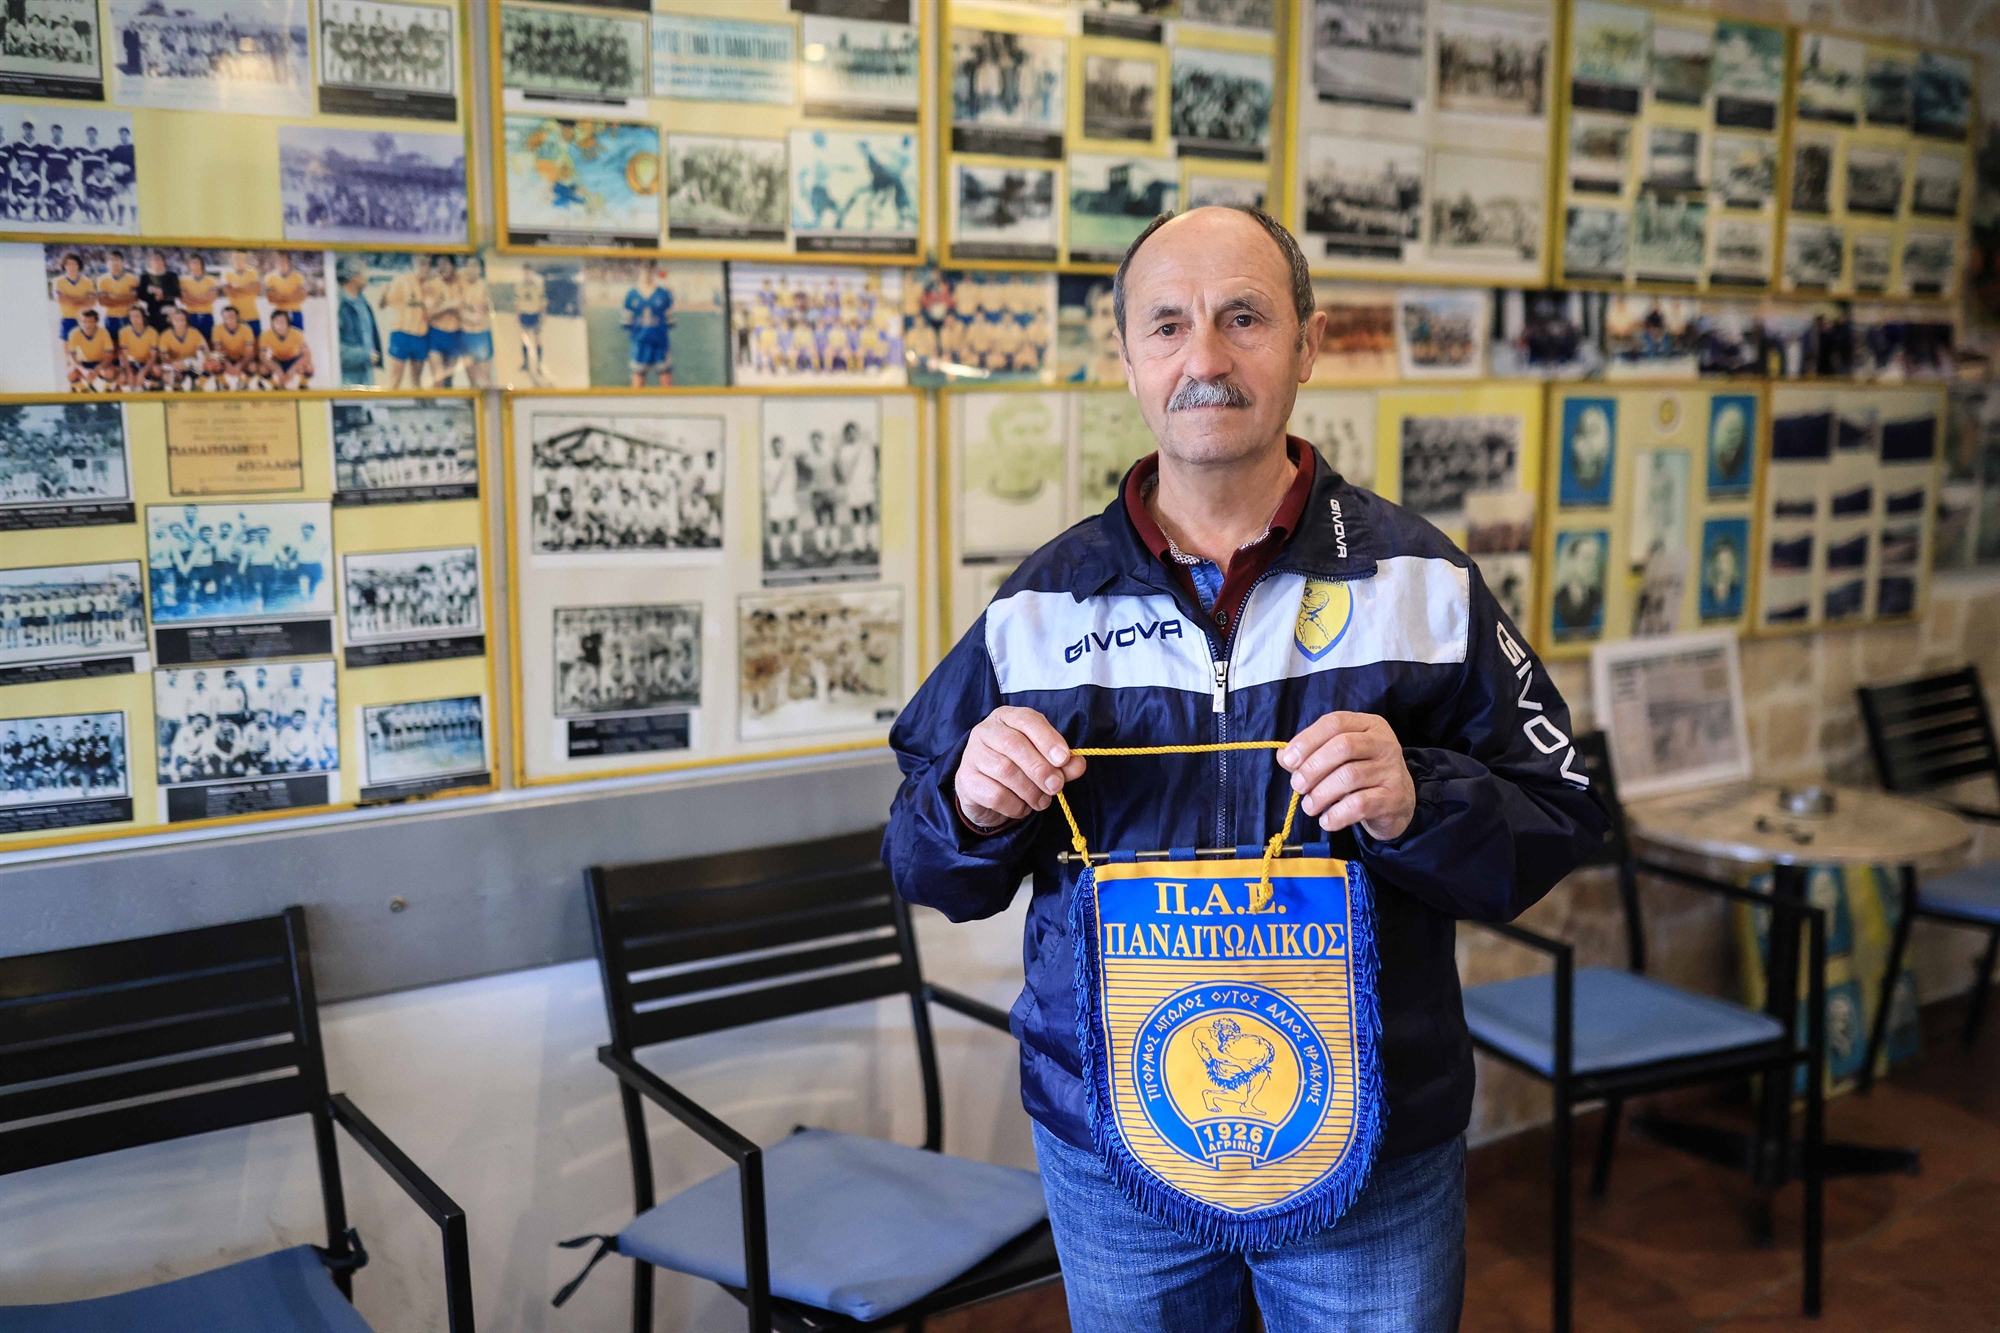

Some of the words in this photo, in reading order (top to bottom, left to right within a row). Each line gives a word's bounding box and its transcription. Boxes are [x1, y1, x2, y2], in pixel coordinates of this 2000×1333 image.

[1330, 498, 1347, 558] GIVOVA
[1065, 619, 1183, 664] GIVOVA
[1496, 621, 1590, 791] GIVOV
[1103, 923, 1346, 958] ΠΑΝΑΙΤΩΛΙΚΟΣ
[1142, 1035, 1162, 1102] ΤΙΤΟΡΜΟΣ
[1154, 994, 1205, 1034] ΑΙΤΩΛΟΣ
[1211, 990, 1260, 1008] ΟΥΤΟΣ
[1266, 1003, 1309, 1042] ΑΛΛΟΣ
[1304, 1045, 1323, 1106] ΗΡΑΚΛΗΣ
[1203, 1123, 1264, 1144] 1926
[1208, 1140, 1261, 1154] ΑΓΡΙΝΙΟ
